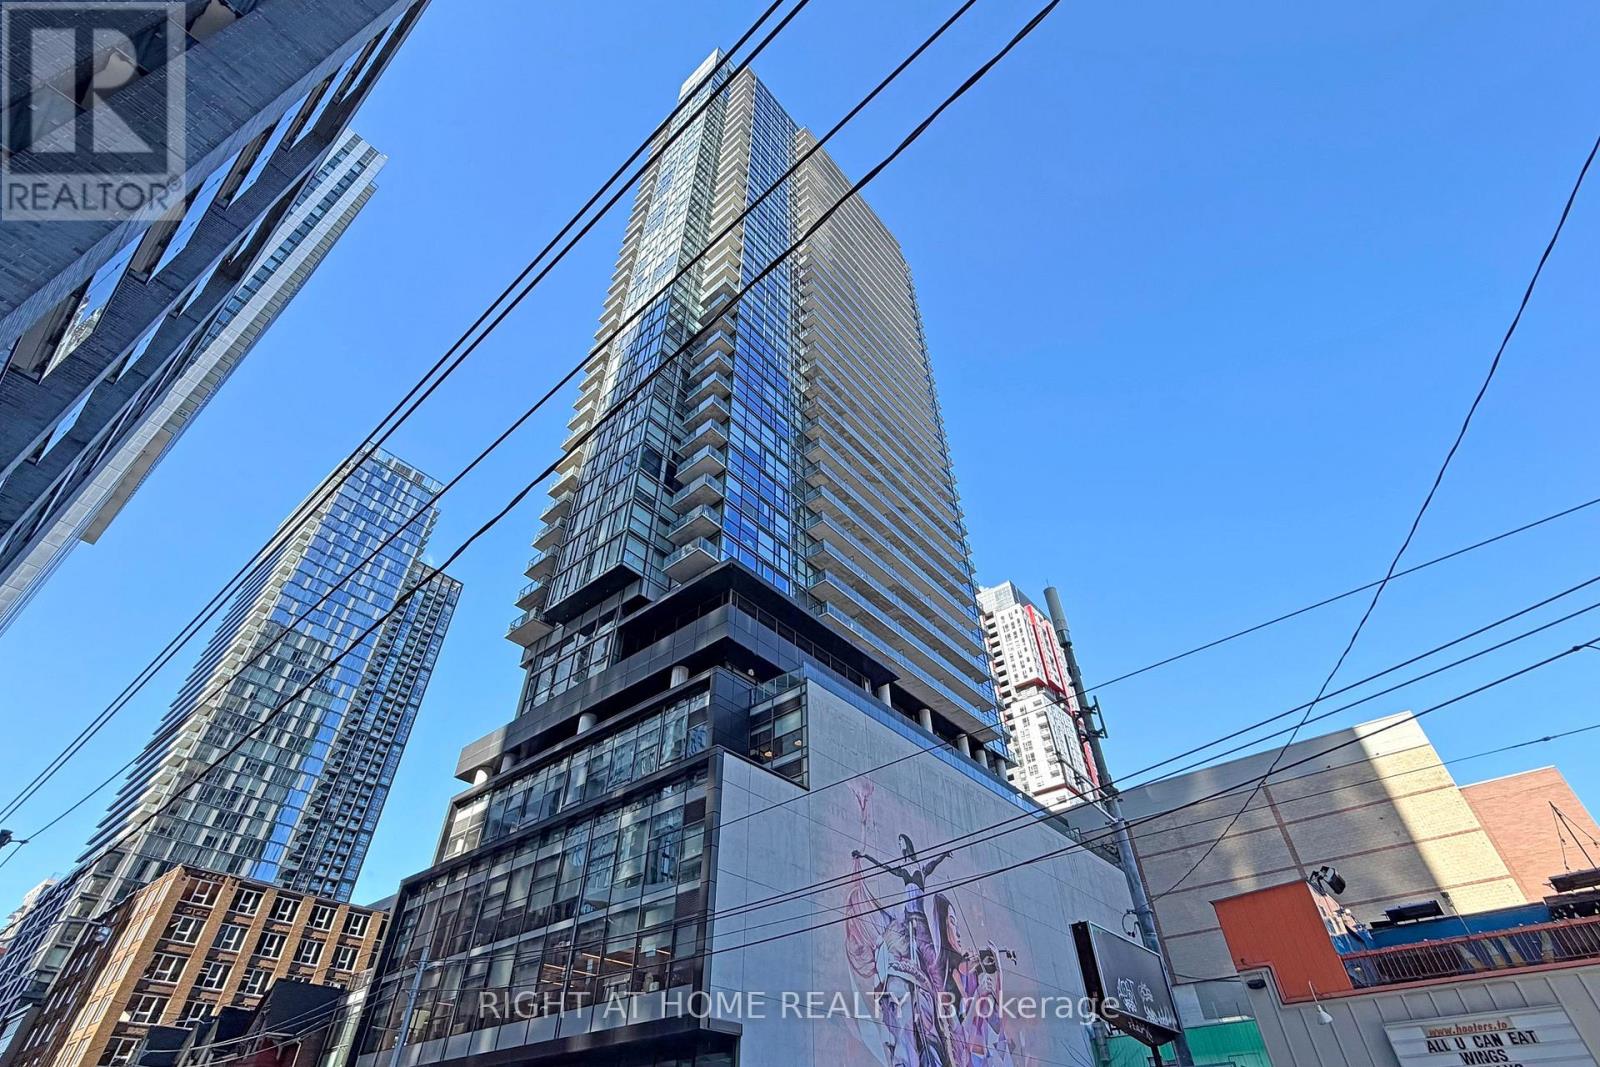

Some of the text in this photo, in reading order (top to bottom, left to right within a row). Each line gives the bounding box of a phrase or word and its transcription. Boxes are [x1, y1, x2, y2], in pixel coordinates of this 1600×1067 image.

[1428, 1020, 1508, 1036] www.hooters.to
[1426, 1030, 1538, 1053] ALL U CAN EAT
[1459, 1049, 1509, 1065] WINGS
